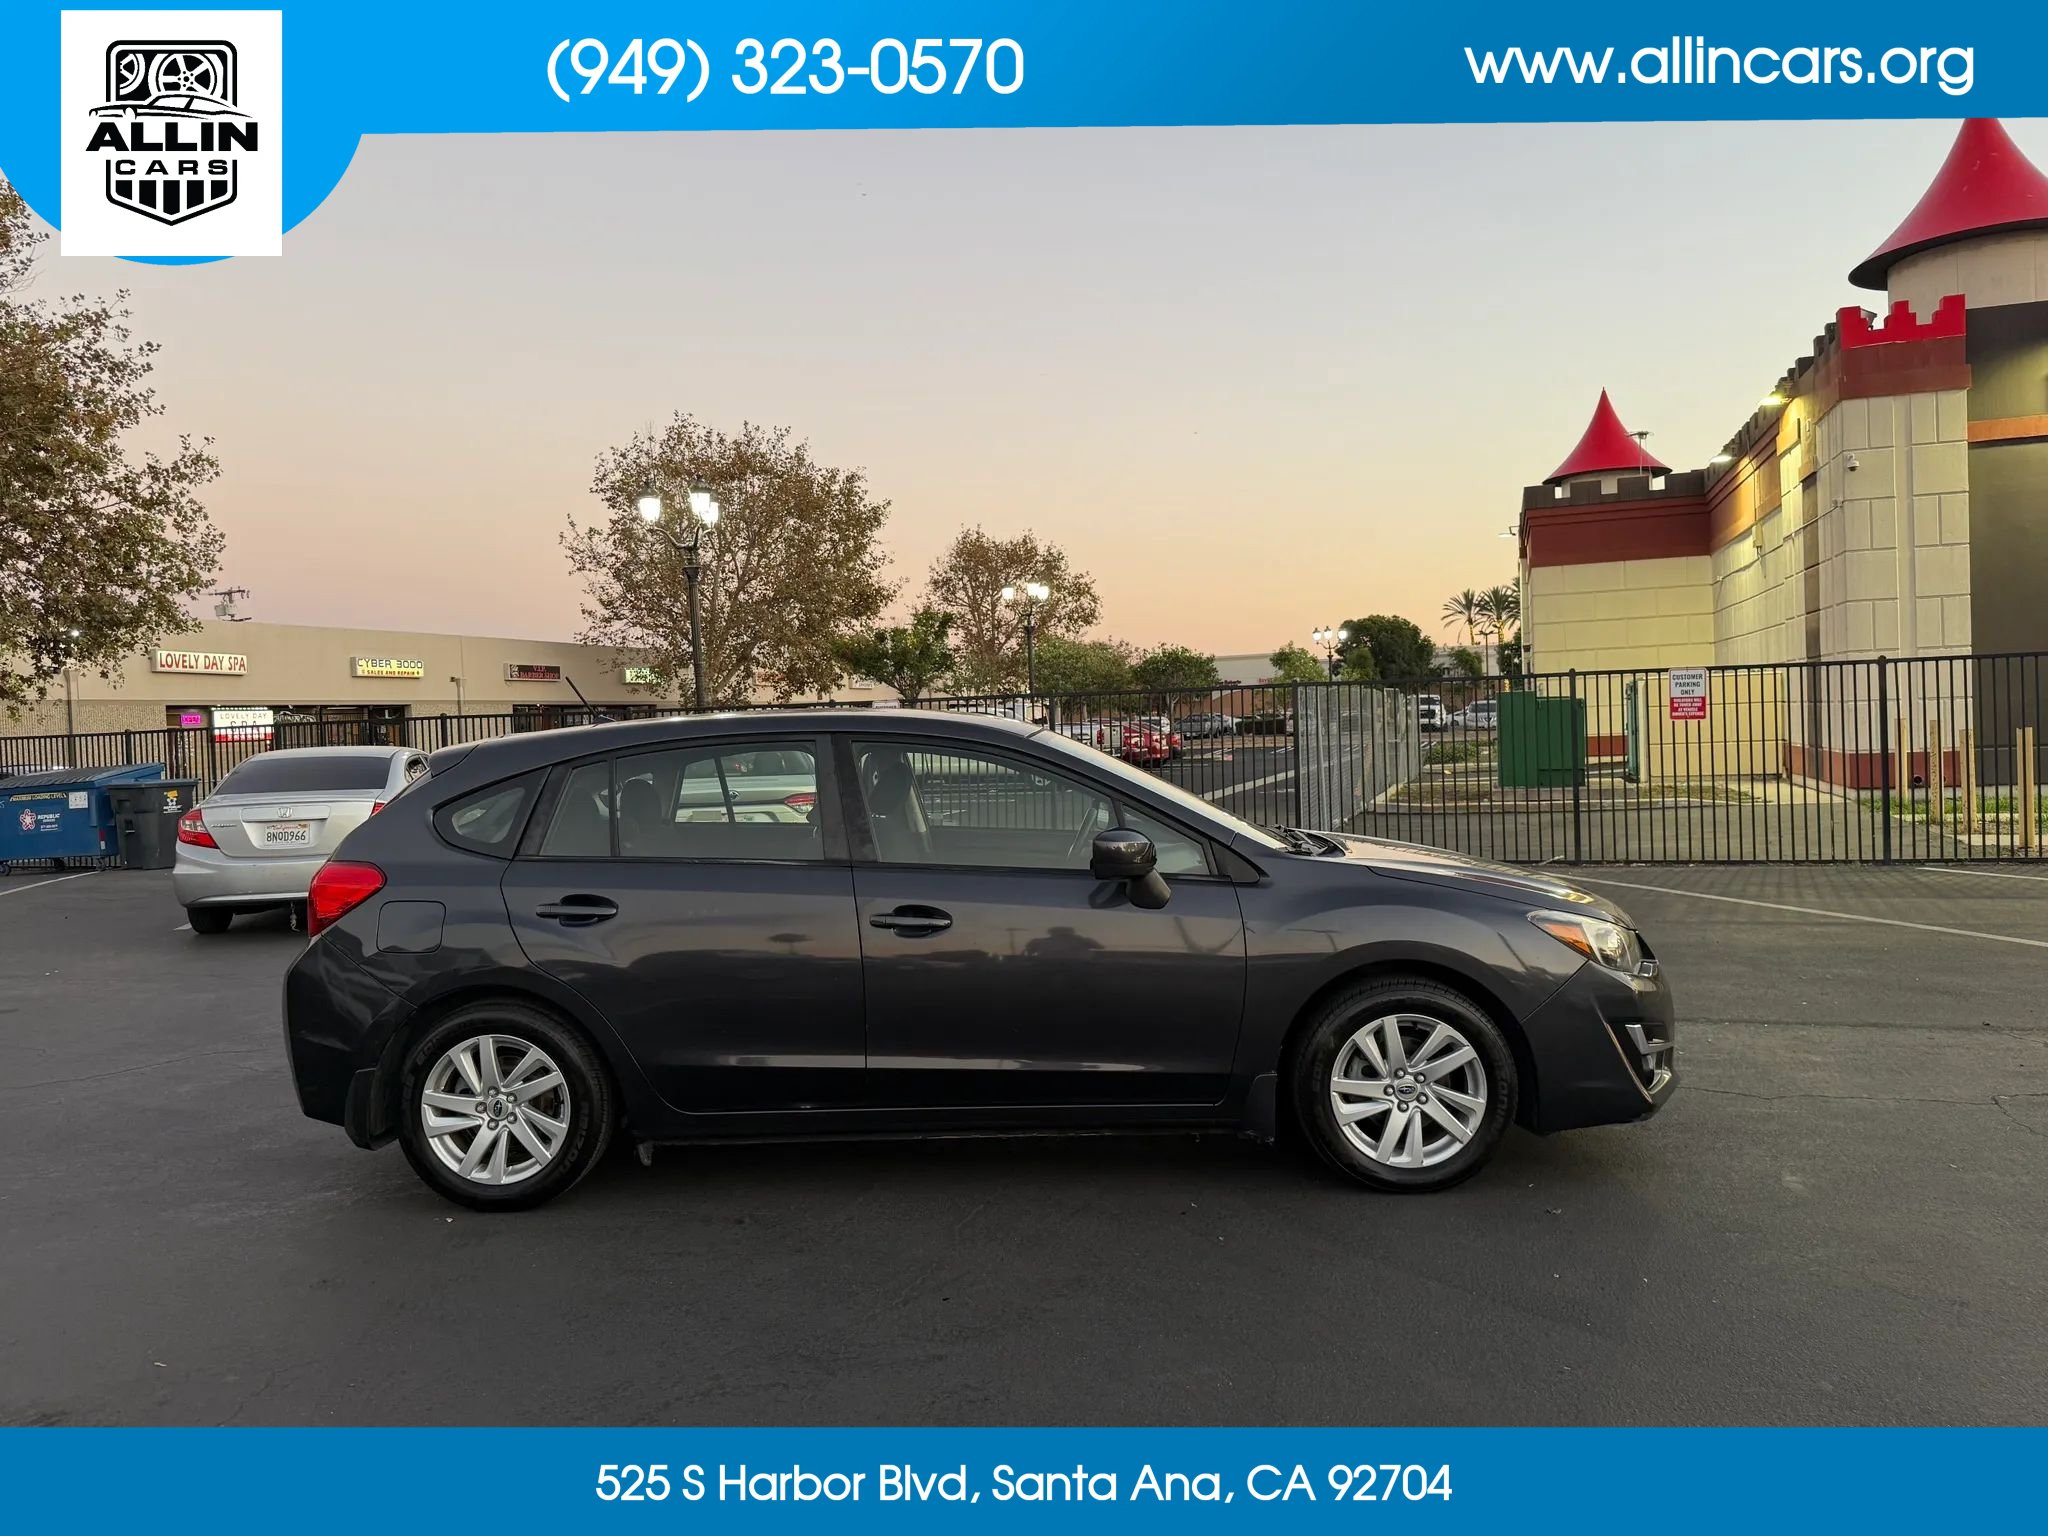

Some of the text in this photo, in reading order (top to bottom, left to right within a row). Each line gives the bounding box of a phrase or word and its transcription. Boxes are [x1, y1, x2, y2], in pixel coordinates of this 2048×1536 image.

[159, 652, 247, 672] LOVELY DAY SPA
[357, 658, 423, 669] CYBER 3000
[220, 712, 249, 720] LOVELY
